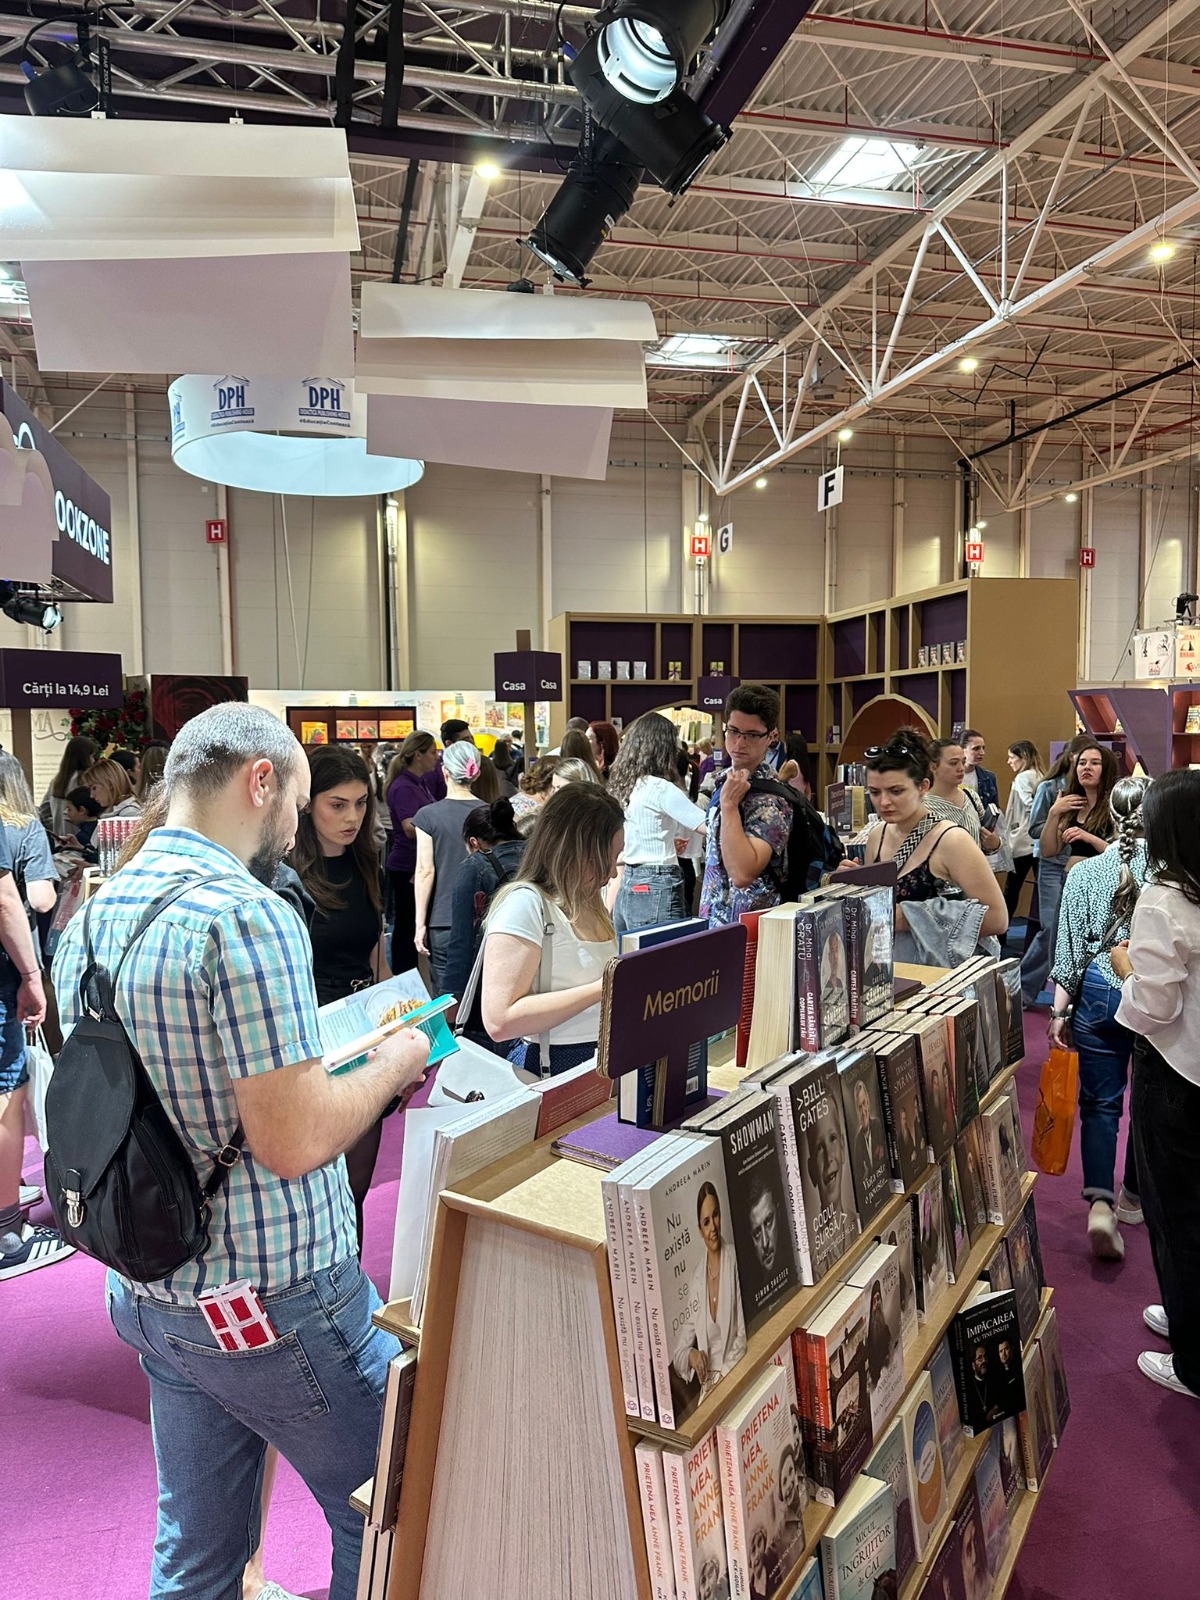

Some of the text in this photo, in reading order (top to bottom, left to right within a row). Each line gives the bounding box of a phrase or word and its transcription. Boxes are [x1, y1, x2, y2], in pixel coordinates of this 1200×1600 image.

[218, 385, 245, 410] DPH
[309, 386, 340, 410] DPH
[824, 472, 836, 507] F
[55, 490, 110, 565] OOKZONE
[211, 524, 222, 538] H
[694, 538, 706, 553] H
[720, 528, 729, 553] G
[969, 544, 980, 559] H
[1084, 552, 1092, 564] H
[22, 682, 109, 698] Cărți la 14,9 Lei
[502, 681, 526, 691] Casa
[541, 679, 557, 690] Casa
[643, 970, 719, 1020] Memorii
[800, 1098, 829, 1132] GATES
[730, 1110, 775, 1154] SHOWMAN
[665, 1160, 711, 1197] ANDREEA MARIN
[667, 1212, 682, 1234] Nu
[813, 1202, 837, 1232] CODUL
[606, 1196, 621, 1280] ANDREEA MARIN
[624, 1199, 637, 1284] ANDREEA MARIN
[638, 1205, 654, 1291] ANDREEA MARIN
[664, 1228, 691, 1261] există
[674, 1259, 686, 1278] nu
[618, 1297, 625, 1309] Nu
[678, 1282, 690, 1302] se
[755, 1283, 770, 1302] SIMON
[634, 1301, 642, 1314] Nu
[651, 1308, 659, 1321] Nu
[619, 1312, 628, 1334] există
[635, 1316, 644, 1339] există
[653, 1323, 662, 1346] există
[966, 1310, 1015, 1340] ÎMPĂCAREA
[622, 1336, 628, 1347] nu
[638, 1341, 644, 1351] nu
[974, 1334, 981, 1344] CU
[656, 1348, 663, 1358] nu
[740, 1393, 780, 1451] PRIETENA
[688, 1427, 717, 1476] PRIETE
[742, 1441, 762, 1472] MEA,
[644, 1462, 652, 1501] PRIETENA
[690, 1470, 713, 1500] MEA,
[744, 1453, 769, 1494] ANNE
[693, 1480, 720, 1521] ANNE
[724, 1439, 740, 1550] PRIETENA MEA, ANNE FRANK
[747, 1470, 775, 1515] FRANK
[648, 1502, 656, 1527] MEA,
[670, 1466, 689, 1583] PRIETENA MEA, ANNE FRANK
[651, 1526, 660, 1548] ANNE
[694, 1510, 723, 1548] FRAN
[855, 1520, 878, 1545] MICUL
[654, 1548, 663, 1579] FRANK
[842, 1524, 892, 1580] ÎNGRIJITOR
[864, 1556, 881, 1581] CAI
